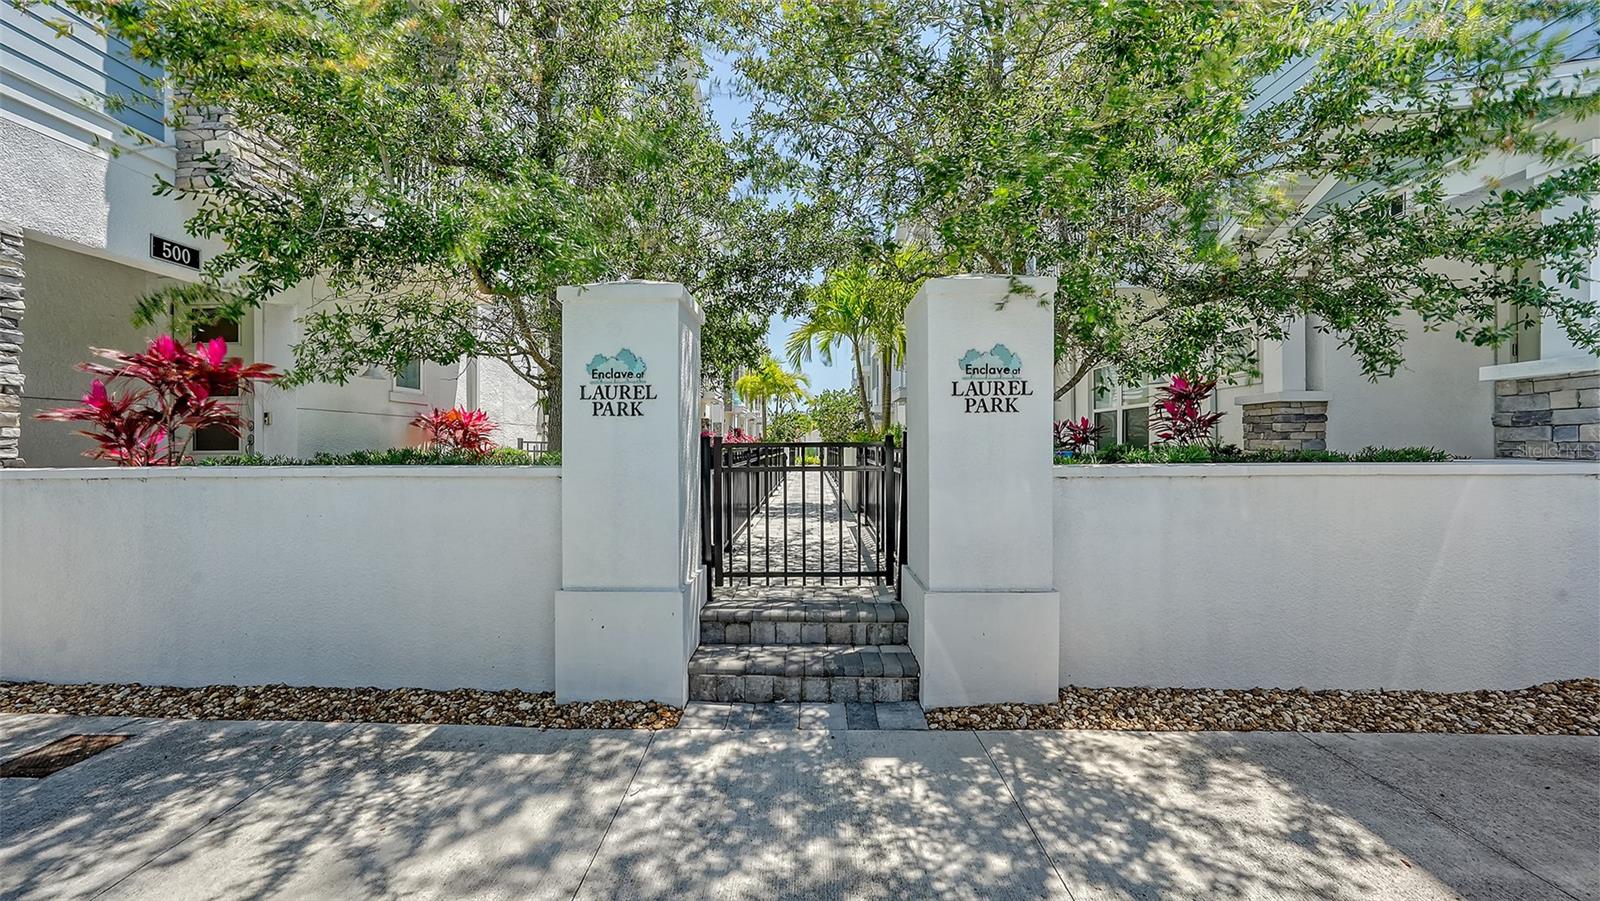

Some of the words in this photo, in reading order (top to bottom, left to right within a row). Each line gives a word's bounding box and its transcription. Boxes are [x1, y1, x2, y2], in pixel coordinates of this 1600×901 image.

[162, 241, 191, 265] 500
[591, 367, 634, 380] Enclave
[965, 362, 1011, 375] Enclave
[579, 384, 658, 401] LAUREL
[951, 380, 1034, 397] LAUREL
[591, 400, 645, 417] PARK
[964, 397, 1020, 414] PARK
